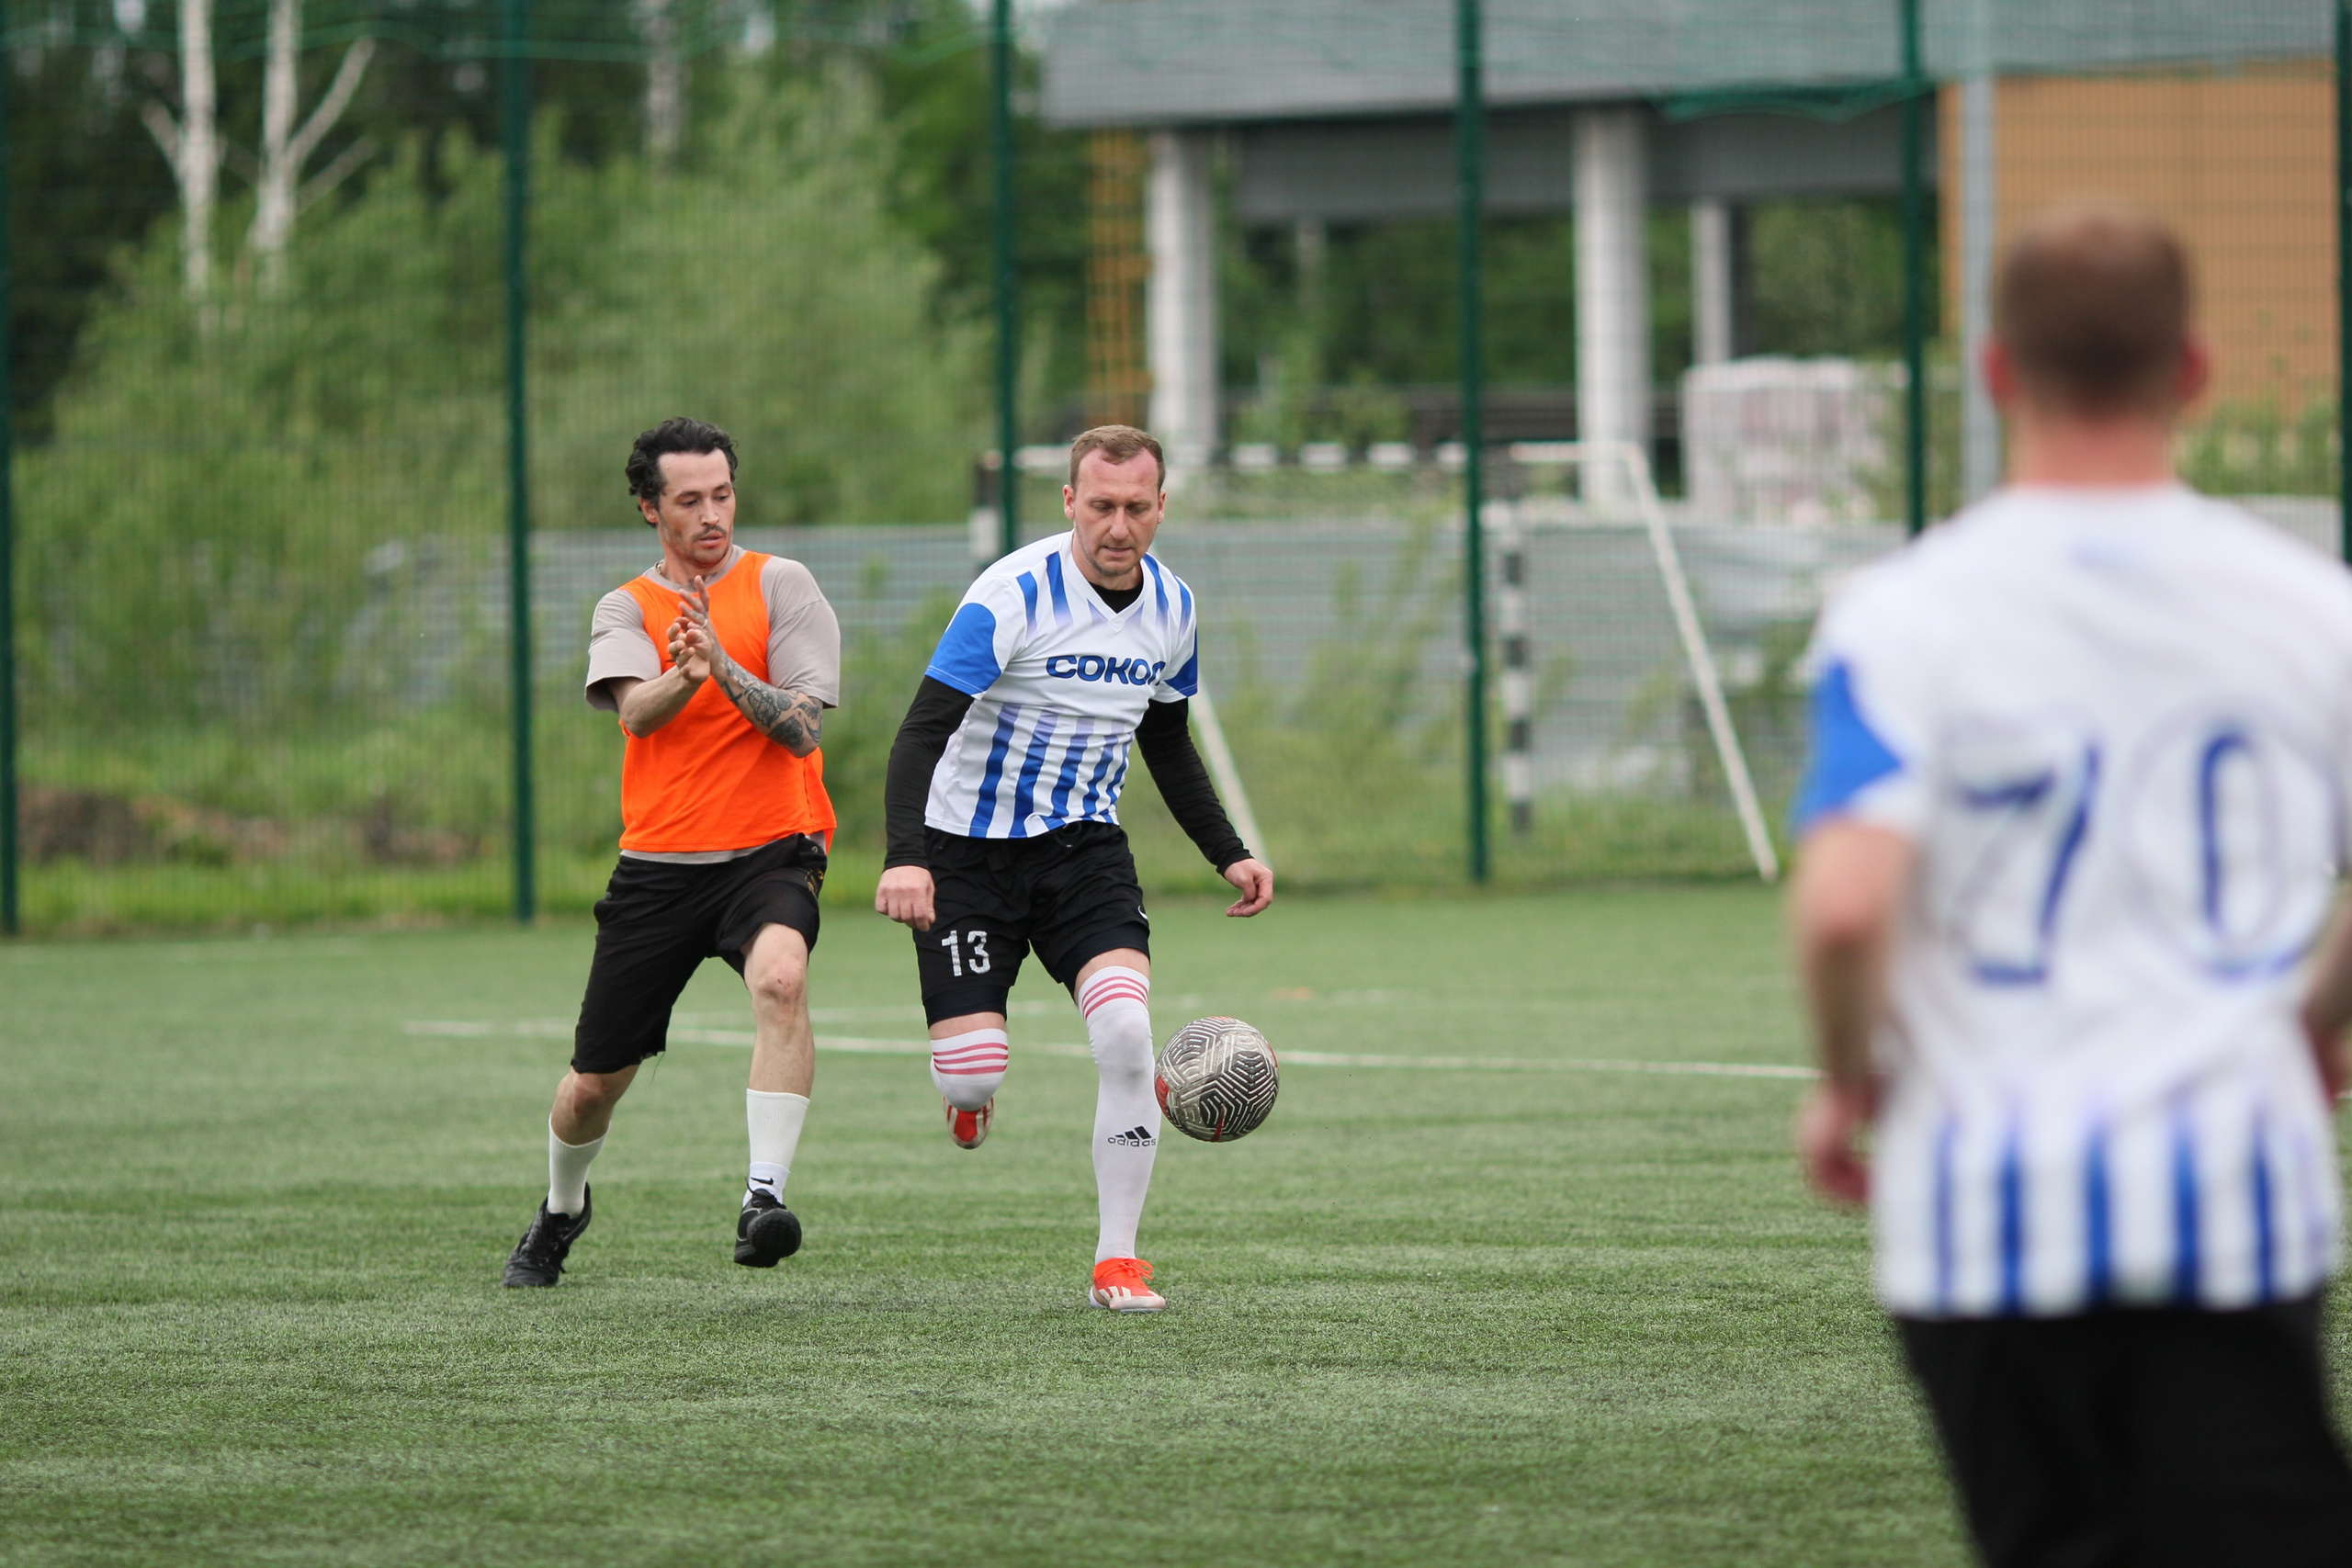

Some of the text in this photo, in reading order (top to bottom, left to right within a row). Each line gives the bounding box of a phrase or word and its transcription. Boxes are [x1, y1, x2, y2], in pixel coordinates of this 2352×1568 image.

[1940, 716, 2339, 994] 70
[941, 930, 991, 976] 13
[1107, 1136, 1157, 1147] adidas
